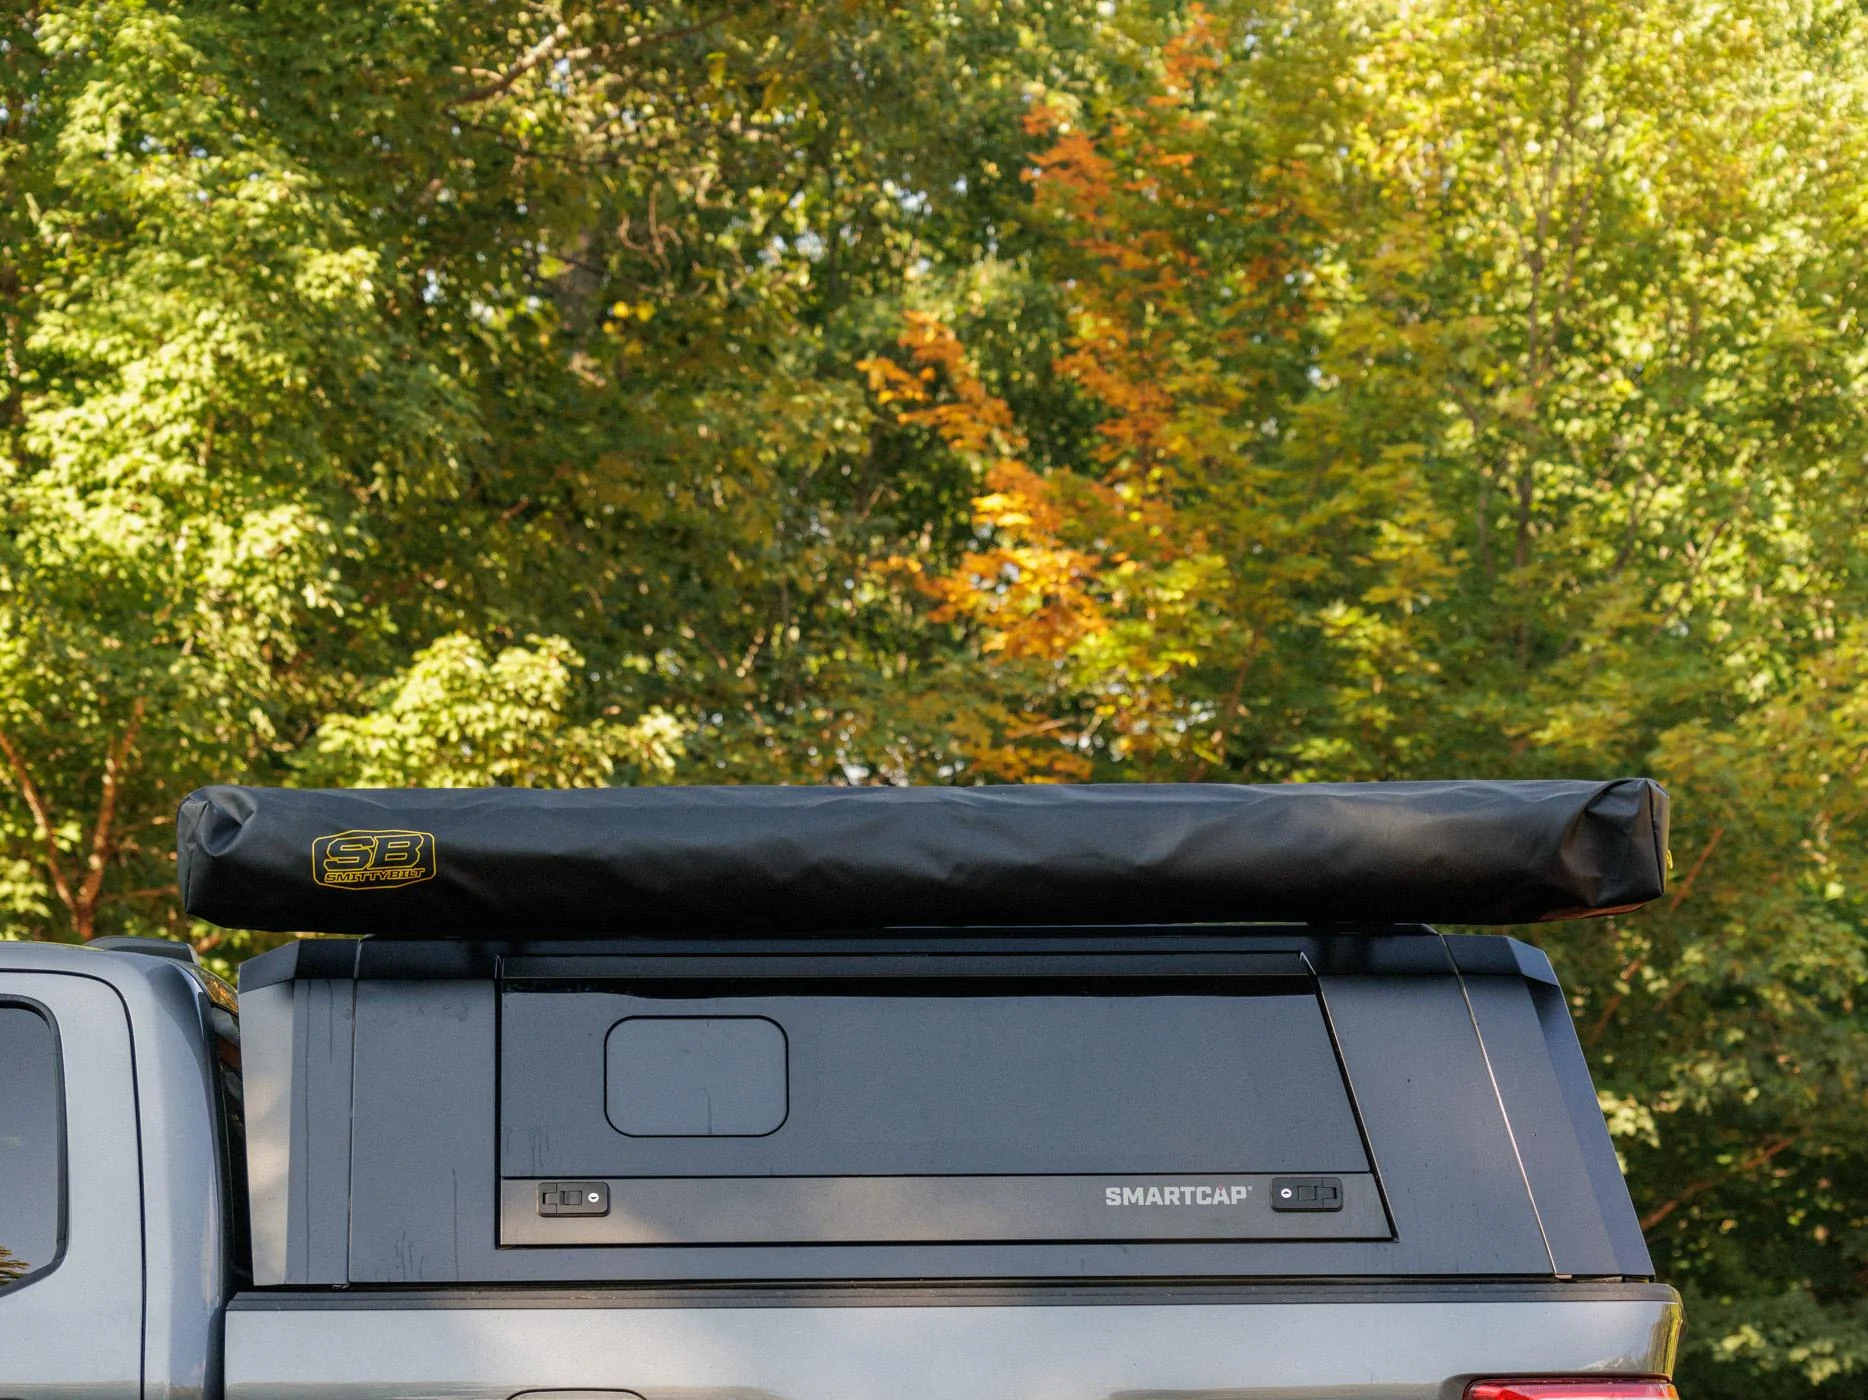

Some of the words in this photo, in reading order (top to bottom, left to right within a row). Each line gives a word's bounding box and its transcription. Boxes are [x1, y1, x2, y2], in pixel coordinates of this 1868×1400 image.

[323, 833, 424, 871] SB
[324, 868, 426, 883] SMITTYBILT
[1105, 1184, 1247, 1206] SMARTCAP
